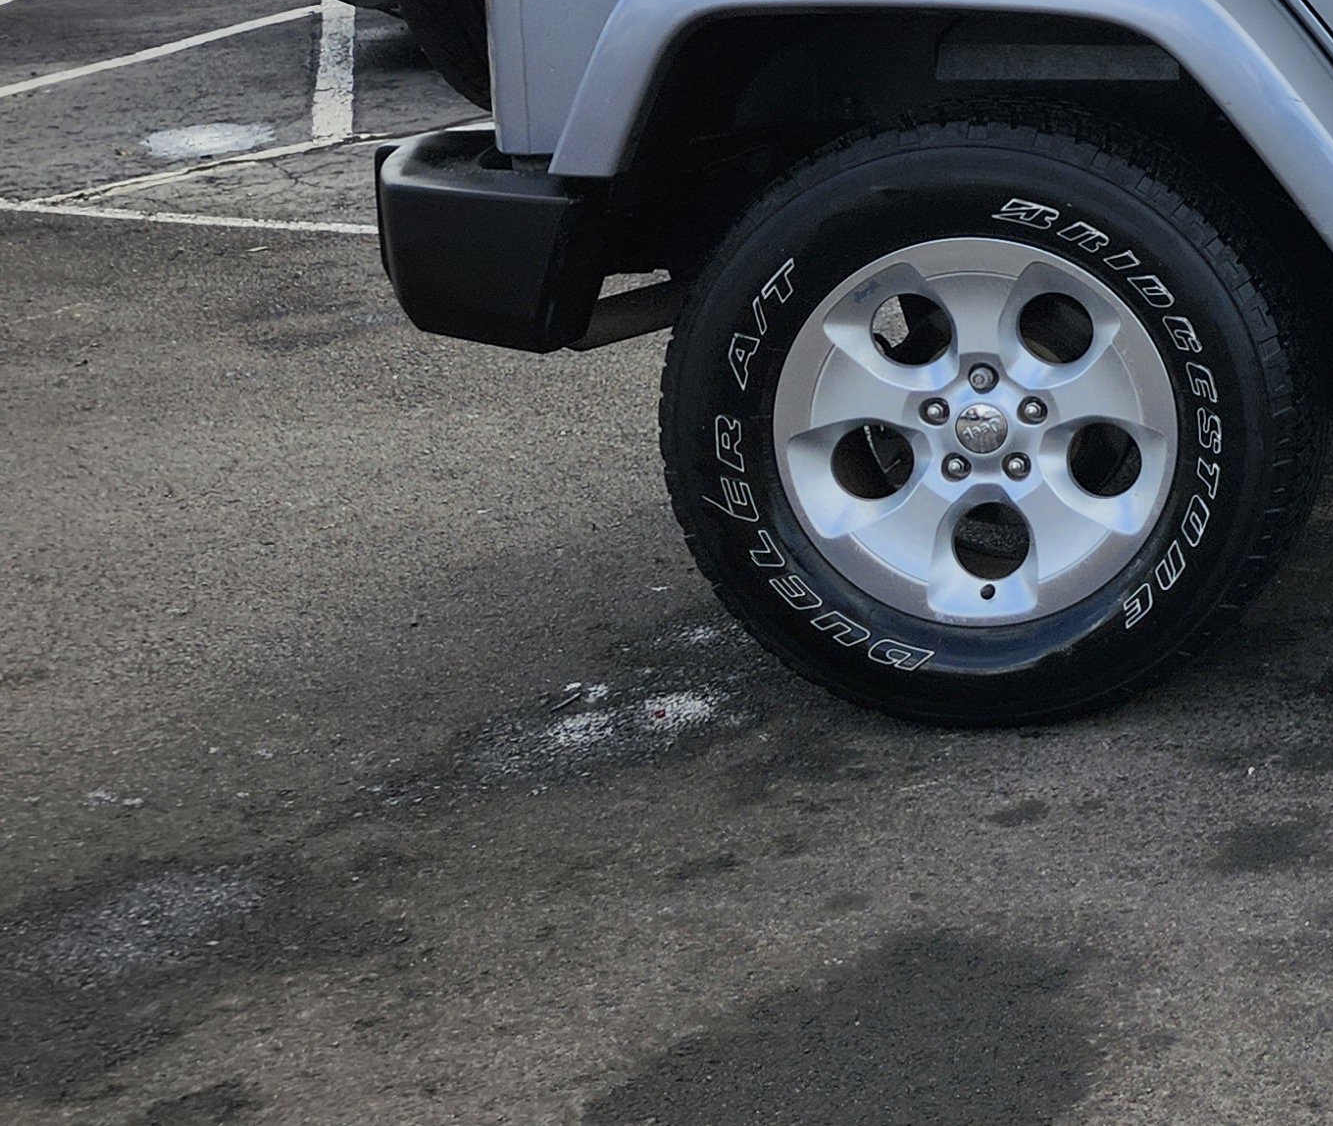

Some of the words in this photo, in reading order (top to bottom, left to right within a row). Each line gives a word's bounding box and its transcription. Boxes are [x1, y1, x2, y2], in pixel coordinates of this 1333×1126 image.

[728, 257, 797, 391] A/T
[991, 198, 1222, 630] BRIDGESTONE
[962, 417, 1001, 441] Jeep
[702, 414, 936, 671] DUELER
